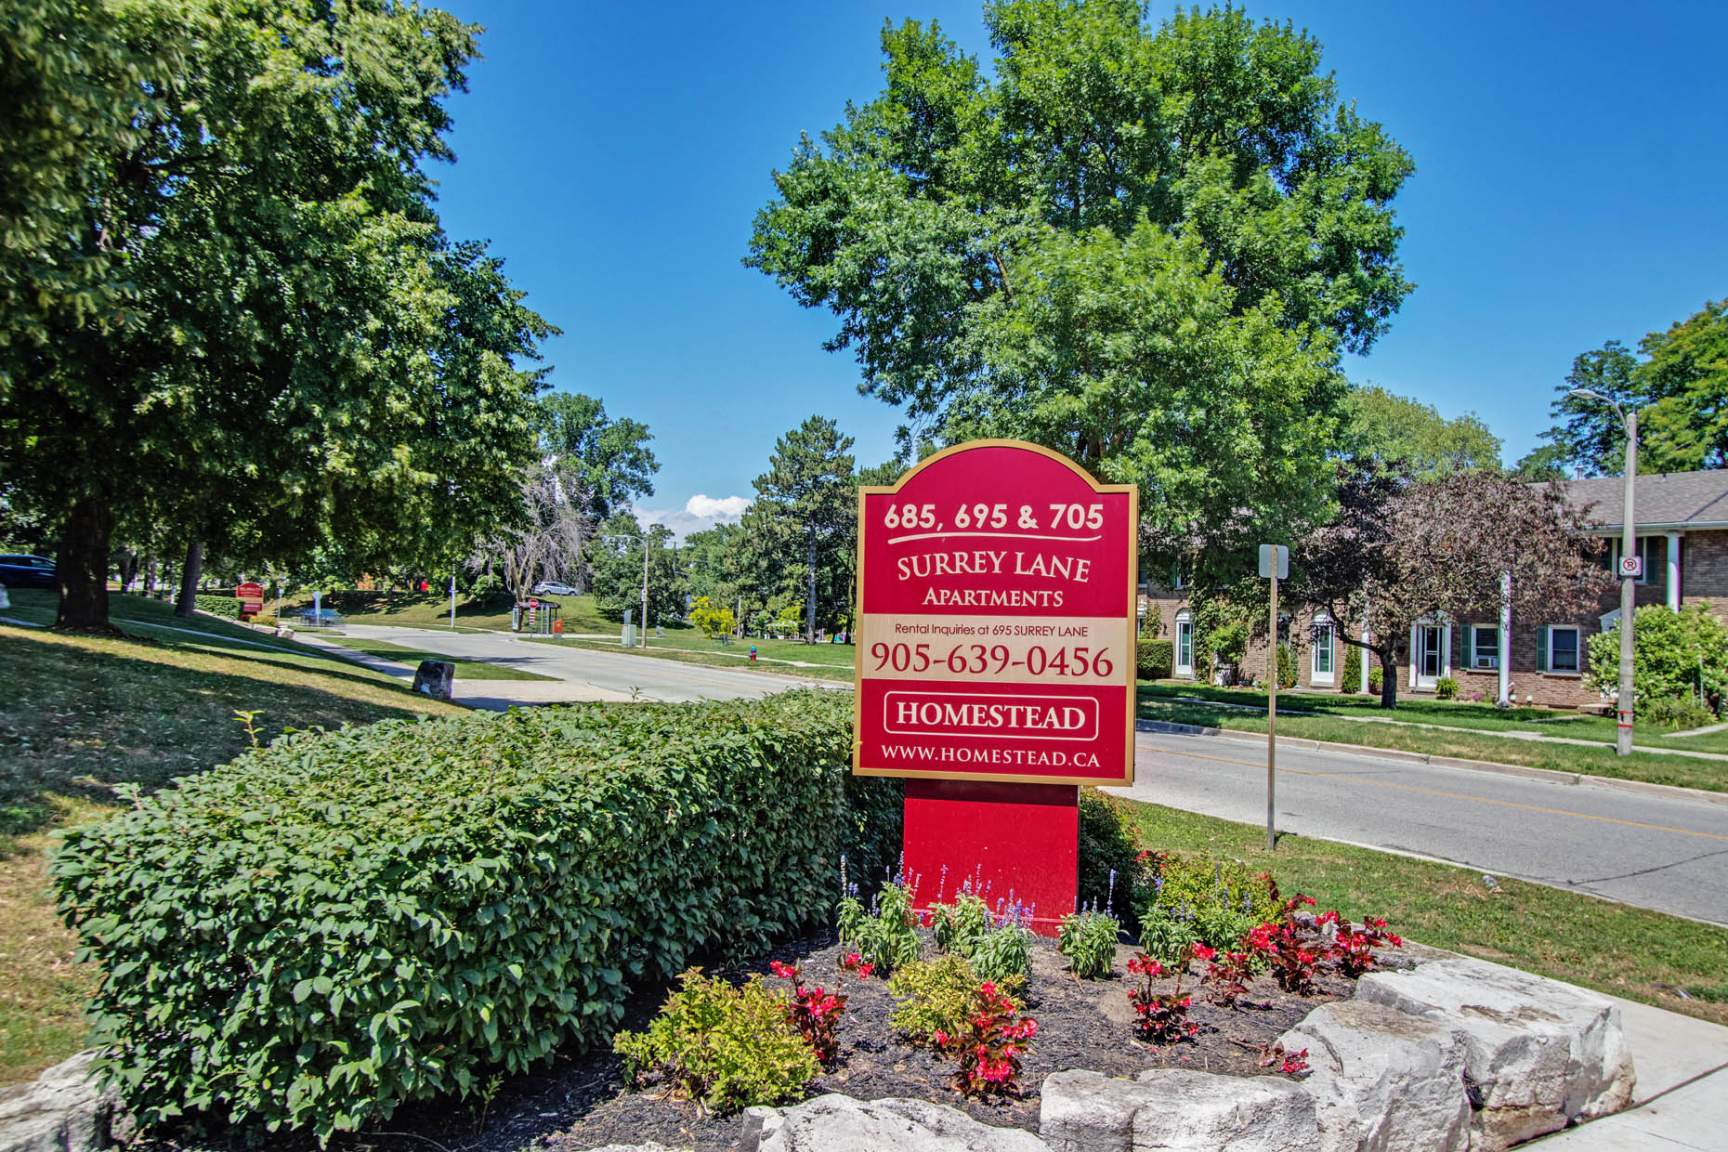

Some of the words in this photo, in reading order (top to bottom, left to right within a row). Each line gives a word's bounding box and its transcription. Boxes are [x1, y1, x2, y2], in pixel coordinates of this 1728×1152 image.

[884, 503, 943, 532] 685,
[954, 503, 1007, 529] 695
[1017, 504, 1039, 529] &
[1049, 503, 1104, 530] 705
[897, 551, 1008, 581] SURREY
[1014, 551, 1091, 583] LANE
[922, 586, 1064, 608] APARTMENTS
[895, 623, 929, 635] Rental
[932, 624, 975, 636] Inquiries
[978, 625, 989, 635] at
[992, 625, 1012, 636] 695
[1014, 625, 1056, 637] SURREY
[1058, 626, 1088, 637] LANE
[871, 642, 1113, 677] 905-639-0456
[896, 701, 1086, 730] HOMESTEAD
[881, 744, 1101, 768] WWW.HOMESTEAD.CA
